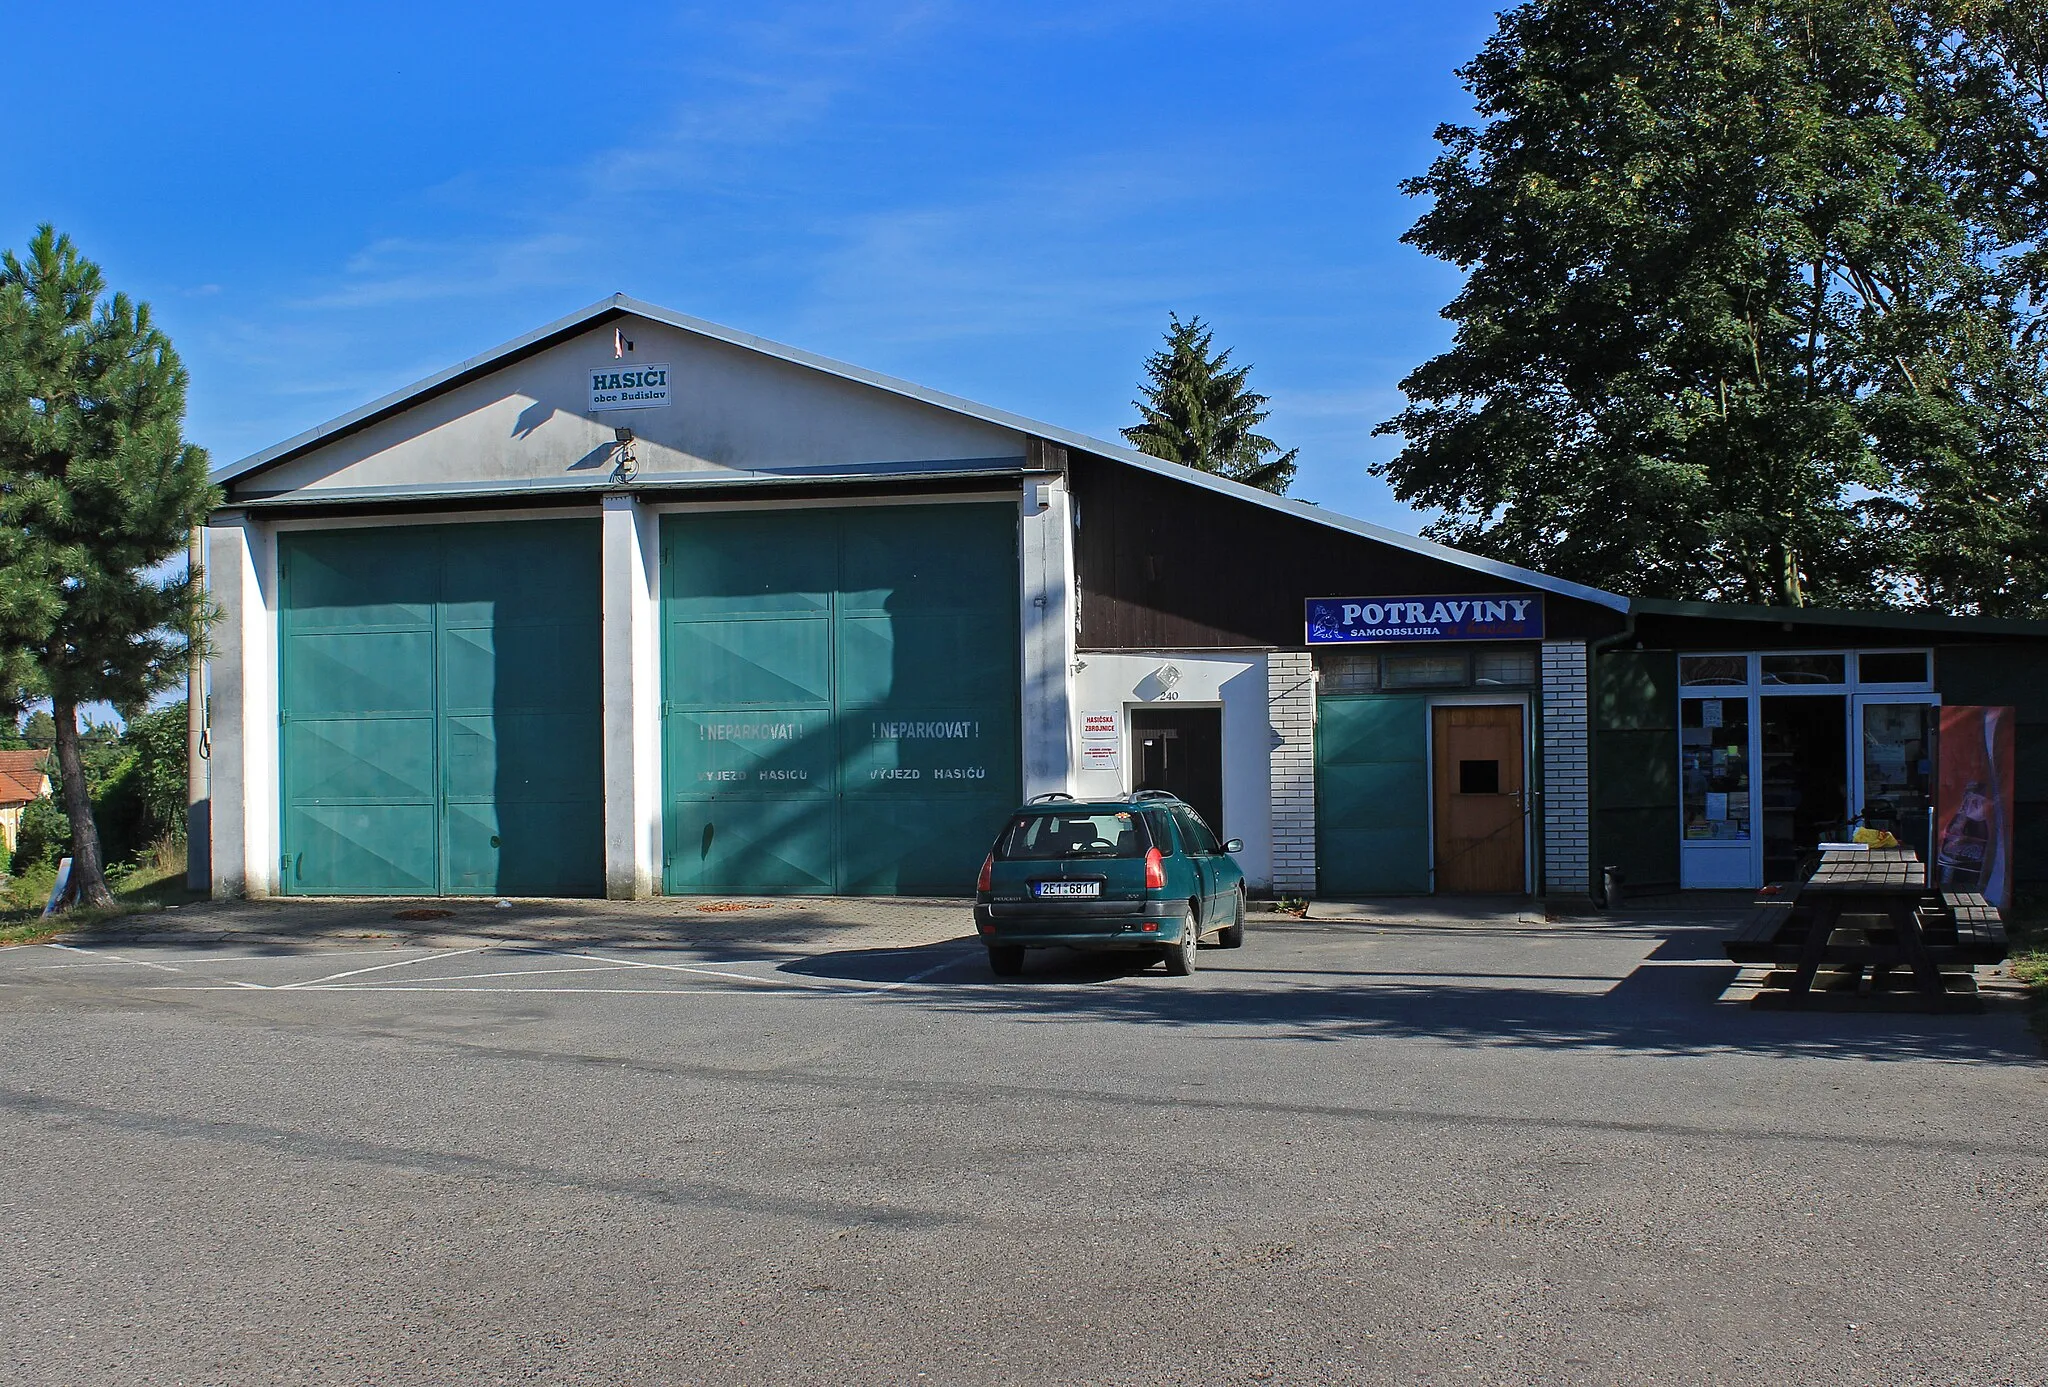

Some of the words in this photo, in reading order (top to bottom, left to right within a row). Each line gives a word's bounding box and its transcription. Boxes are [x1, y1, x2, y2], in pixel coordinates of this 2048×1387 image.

[593, 366, 666, 390] HASIČI
[594, 394, 617, 403] obce
[621, 391, 666, 401] Budislav
[1342, 600, 1531, 625] POTRAVINY
[1350, 627, 1440, 637] SAMOOBSLUHA
[1159, 691, 1179, 700] 240
[1086, 715, 1114, 723] HASIČSKÁ
[707, 723, 794, 740] NEPARKOVAT
[880, 721, 971, 739] NEPARKOVAT
[1043, 883, 1062, 894] 2E1
[1069, 883, 1095, 894] 6811
